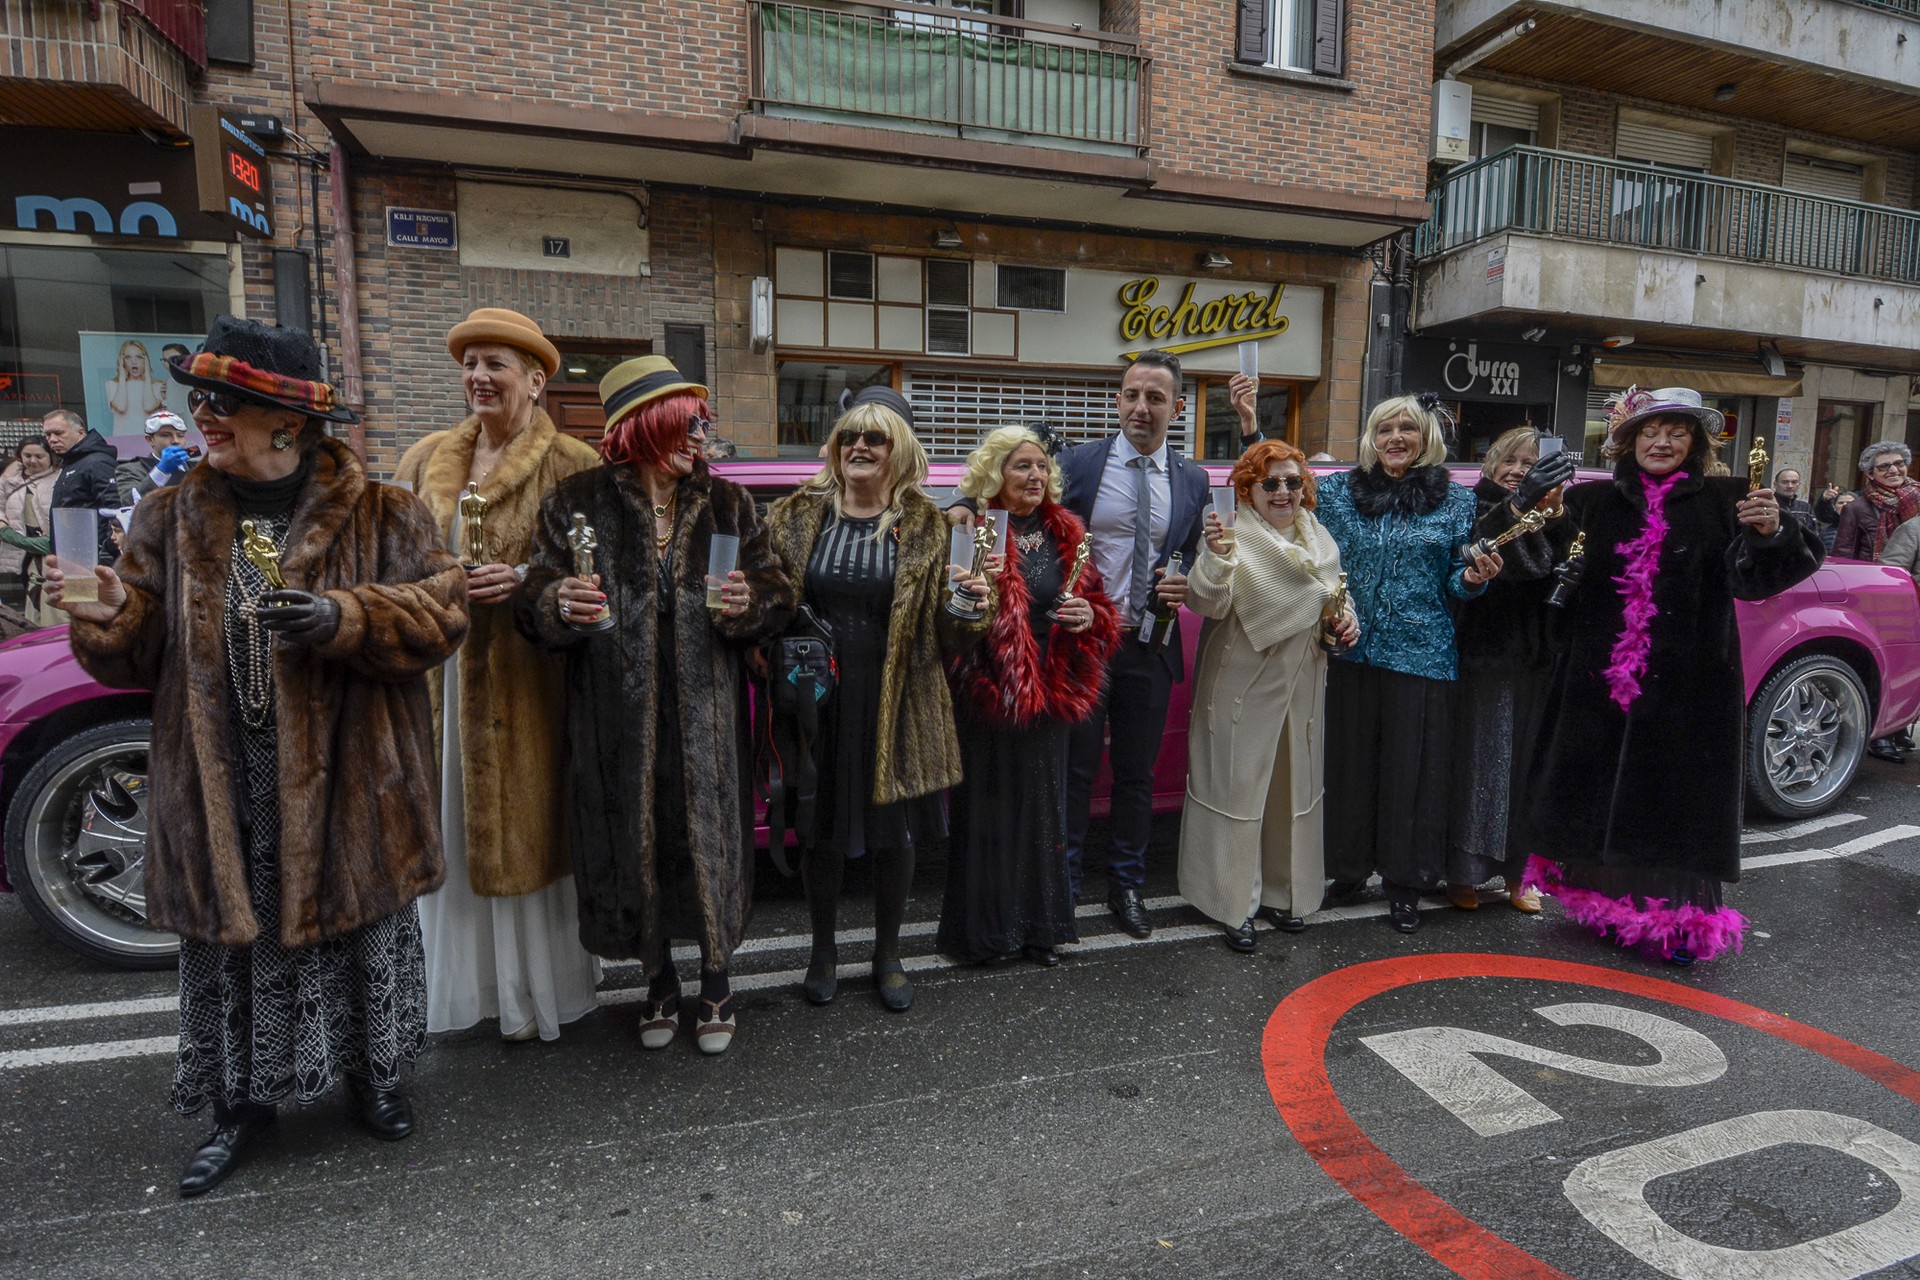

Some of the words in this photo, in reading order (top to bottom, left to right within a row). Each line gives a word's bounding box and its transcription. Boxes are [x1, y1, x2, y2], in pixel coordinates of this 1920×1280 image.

[393, 212, 414, 221] KALE
[396, 234, 419, 242] CALLE
[422, 236, 449, 245] MAYOR
[549, 240, 564, 254] 17
[1358, 1002, 1920, 1280] 20
